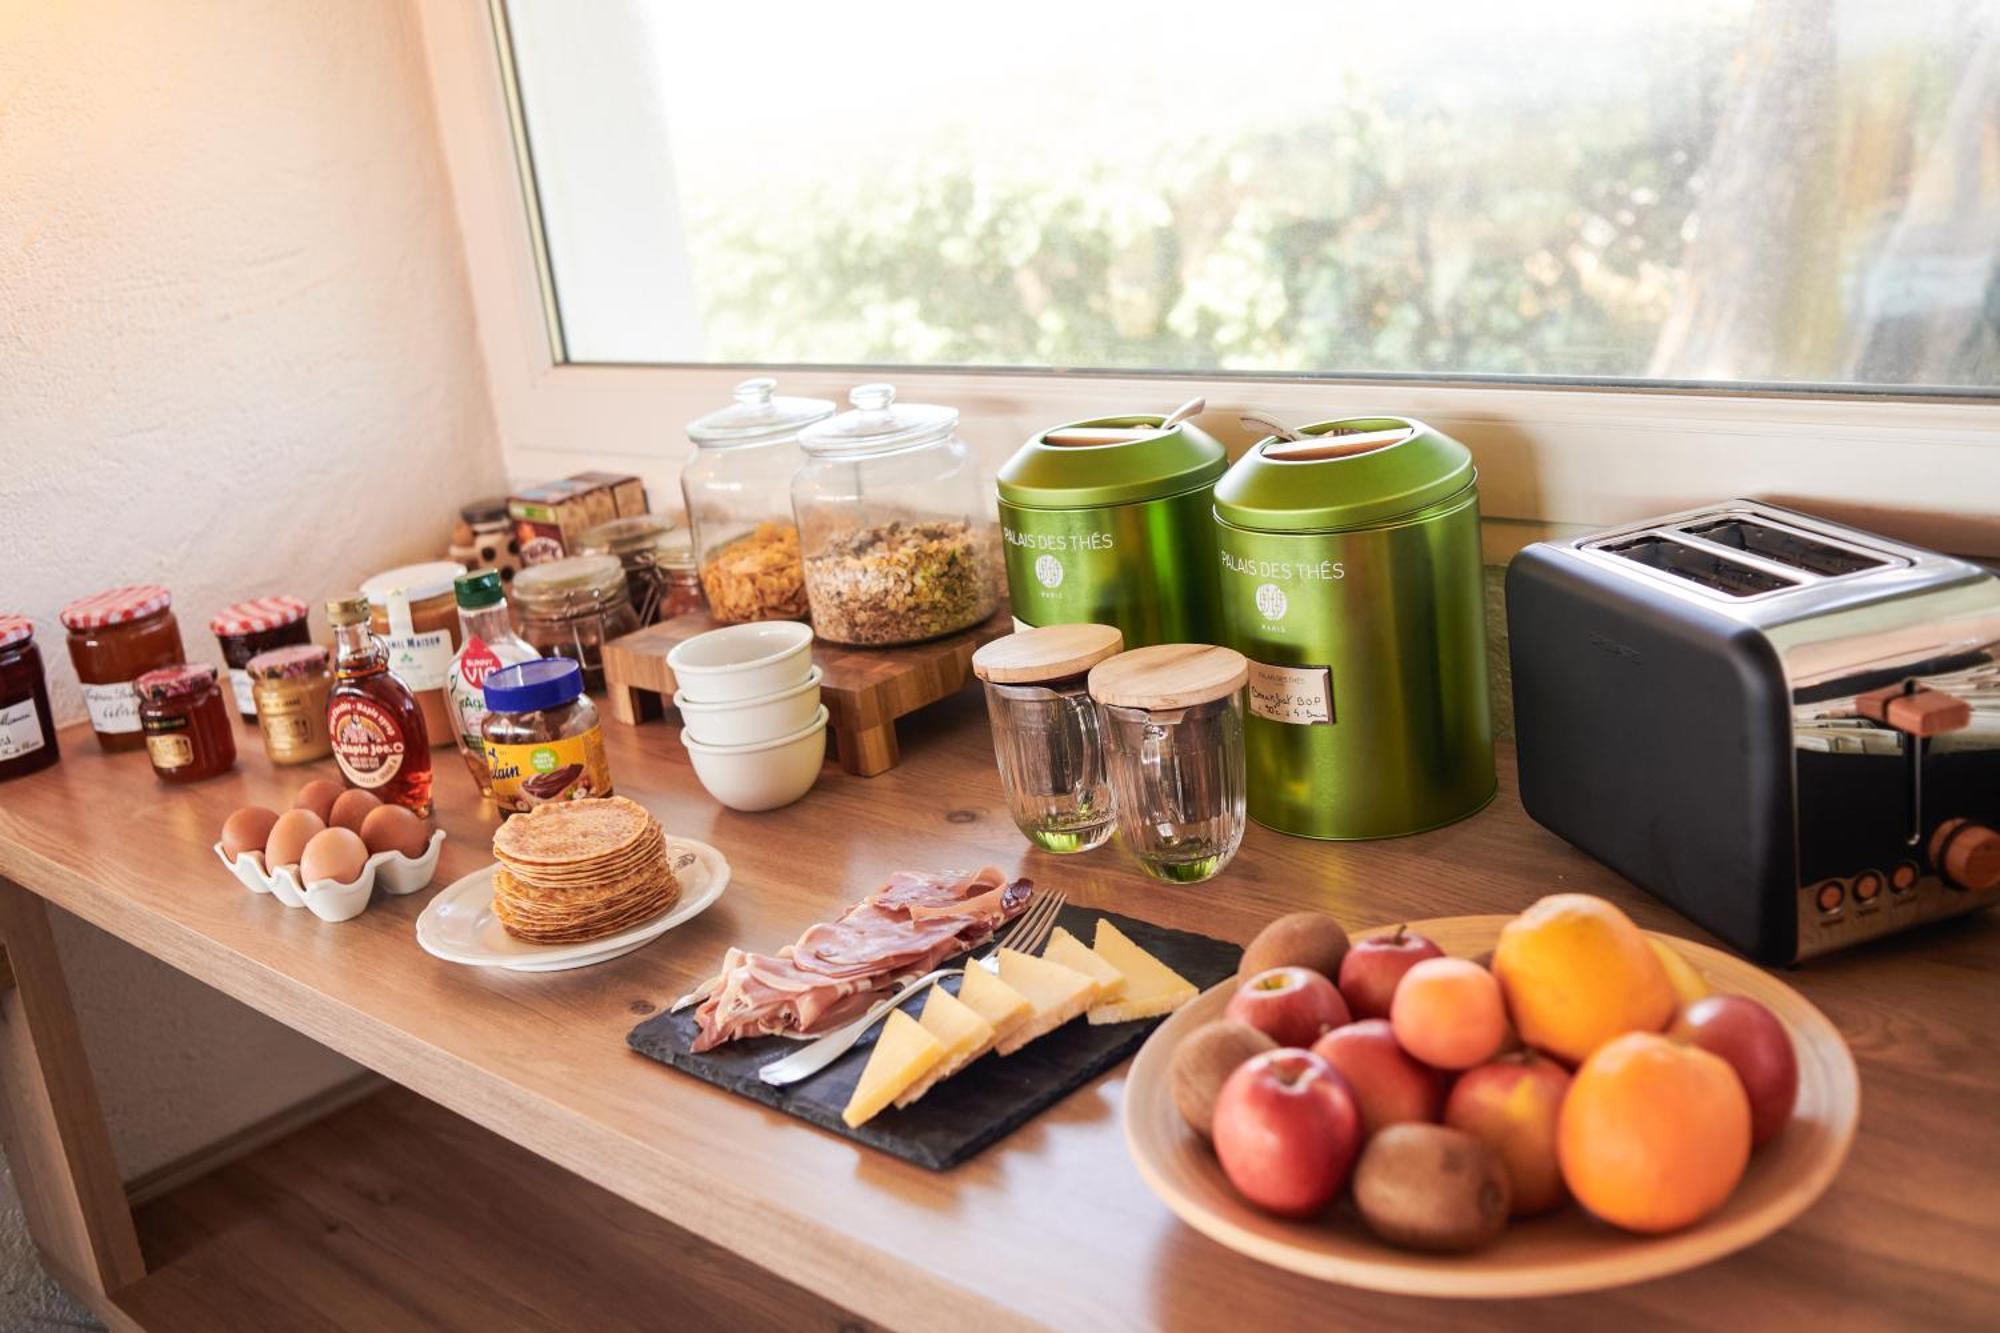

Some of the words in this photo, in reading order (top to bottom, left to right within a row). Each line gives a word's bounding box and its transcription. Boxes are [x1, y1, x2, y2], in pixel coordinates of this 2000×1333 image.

[1003, 527, 1036, 549] PALAIS
[1038, 535, 1067, 551] DES
[1068, 531, 1113, 551] THÉS
[1221, 550, 1257, 576] PALAIS
[1260, 561, 1292, 580] DES
[1296, 560, 1345, 580] THÉS
[1261, 624, 1286, 633] PARIS
[407, 636, 440, 649] MAISON
